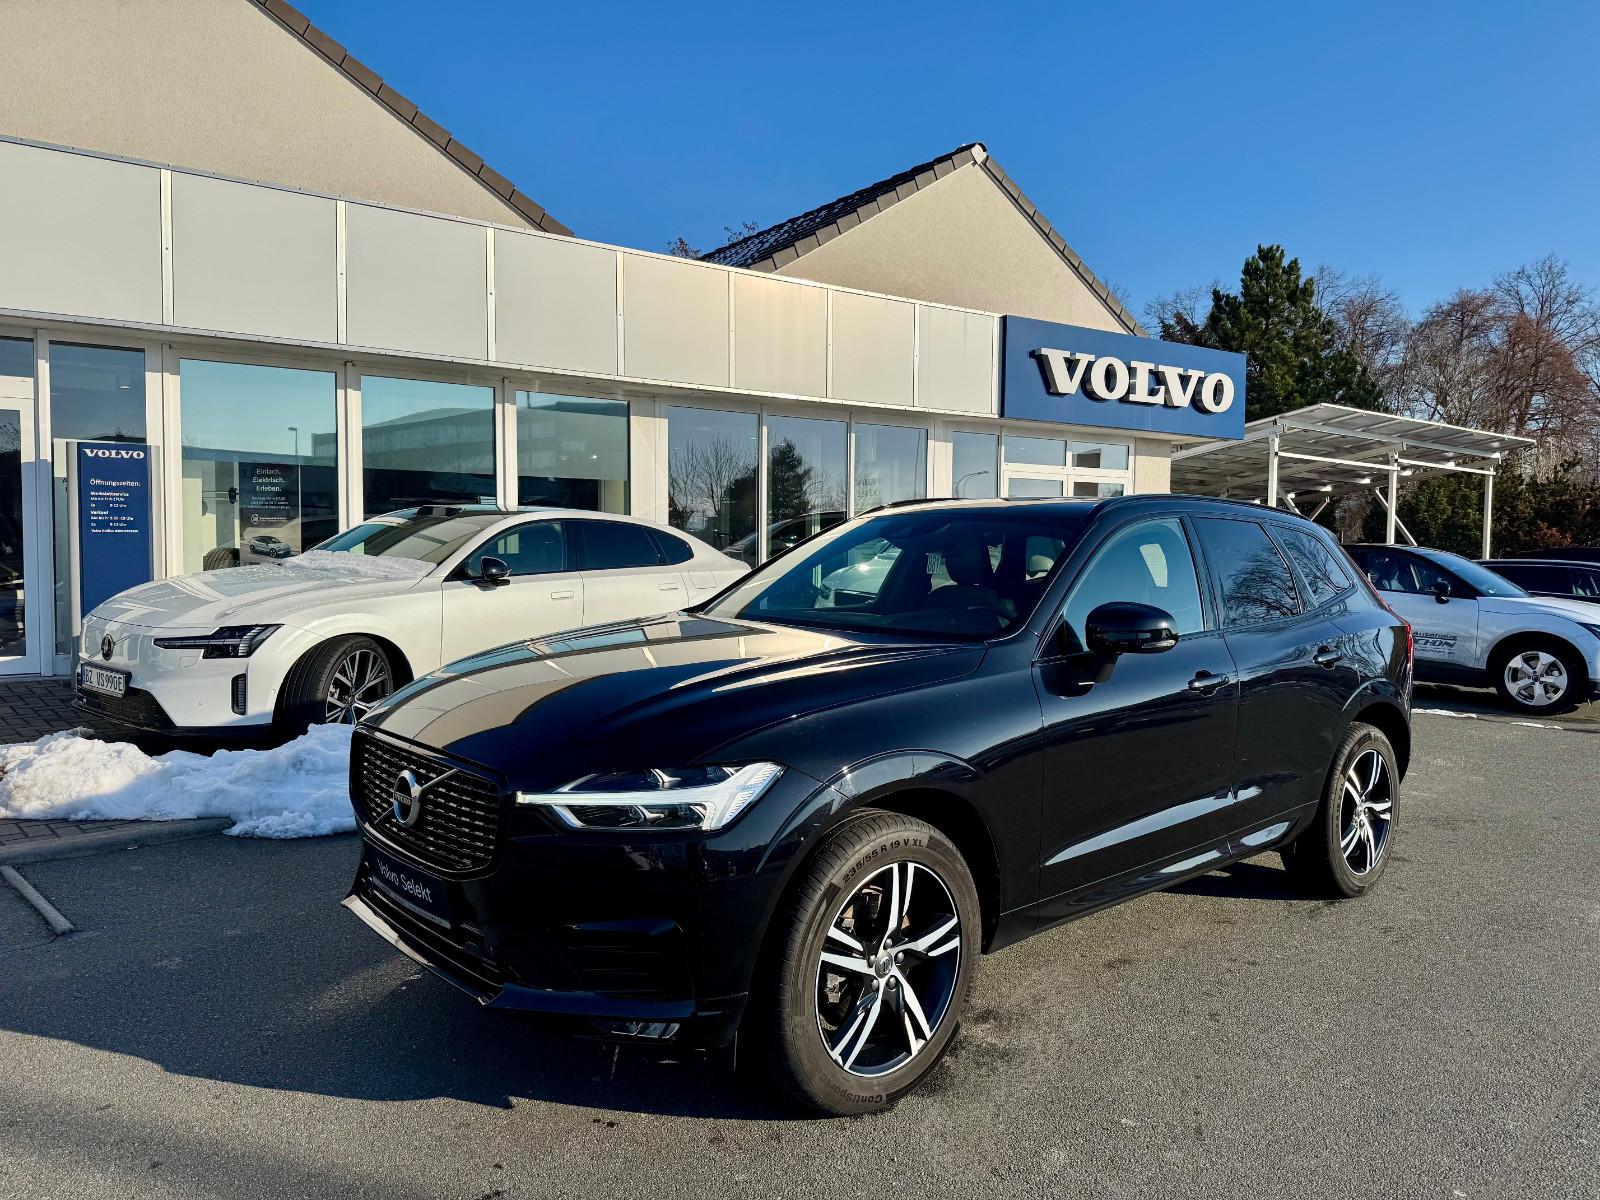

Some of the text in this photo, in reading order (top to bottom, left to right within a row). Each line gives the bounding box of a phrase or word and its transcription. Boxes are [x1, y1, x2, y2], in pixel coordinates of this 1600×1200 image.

[1036, 347, 1235, 414] VOLVO
[83, 448, 145, 459] VOLVO
[90, 478, 141, 487] Öffnungszeiten:
[1412, 630, 1458, 641] Autohaus
[842, 838, 924, 885] 235/55 R 19 V XL
[377, 857, 433, 903] Volvo Selekt
